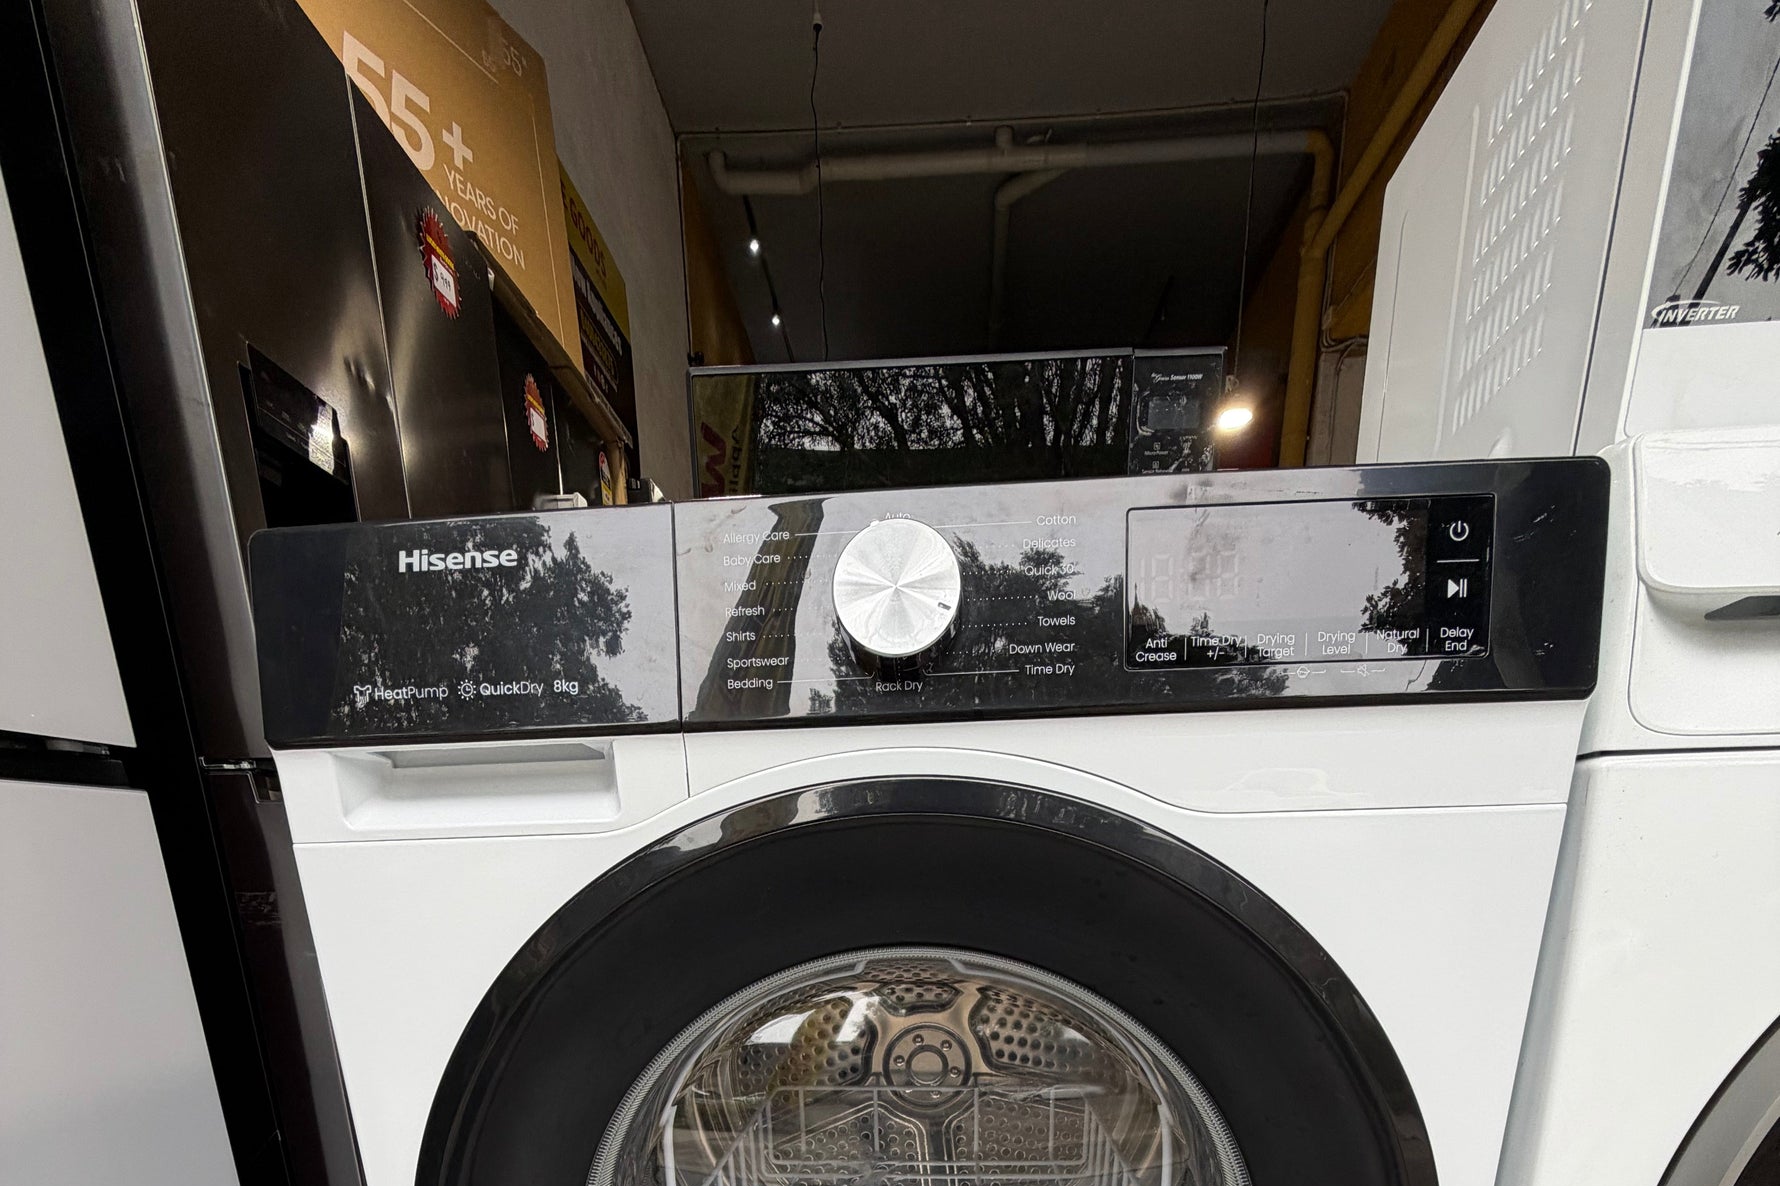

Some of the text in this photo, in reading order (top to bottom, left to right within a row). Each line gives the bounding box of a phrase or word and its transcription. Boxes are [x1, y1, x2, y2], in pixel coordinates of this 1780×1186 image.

[444, 163, 519, 235] YEARS OF
[1658, 304, 1740, 323] INVERTER
[1036, 515, 1076, 526] Cotton
[723, 530, 790, 544] Allergy Care
[1023, 537, 1076, 549] Delicates
[398, 549, 518, 573] Hisense
[723, 554, 781, 567] Baby Care
[1024, 564, 1074, 575] Quick 30
[724, 580, 756, 592] Mixed
[1047, 589, 1076, 601] Wool
[725, 605, 765, 618] Refresh
[1037, 614, 1076, 627] Towels
[726, 631, 756, 642] Shirts
[1257, 632, 1295, 646] Drying
[1317, 630, 1356, 644] Drying
[1376, 627, 1420, 640] Natural
[1440, 627, 1474, 639] Delay
[1009, 642, 1076, 654] Down Wear
[1145, 637, 1168, 649] Anti
[1190, 635, 1242, 648] Time Dry
[1445, 640, 1467, 651] End
[1206, 646, 1225, 661] +/-
[1258, 647, 1295, 660] Target
[1322, 644, 1350, 655] Level
[1387, 643, 1408, 655] Dry
[1135, 650, 1177, 662] Crease
[727, 656, 790, 671] Sportswear
[1024, 663, 1075, 676] Time Dry
[375, 679, 579, 701] HeatPump QuickDry 8kg
[727, 678, 773, 690] Bedding
[875, 680, 923, 693] Rack Dry
